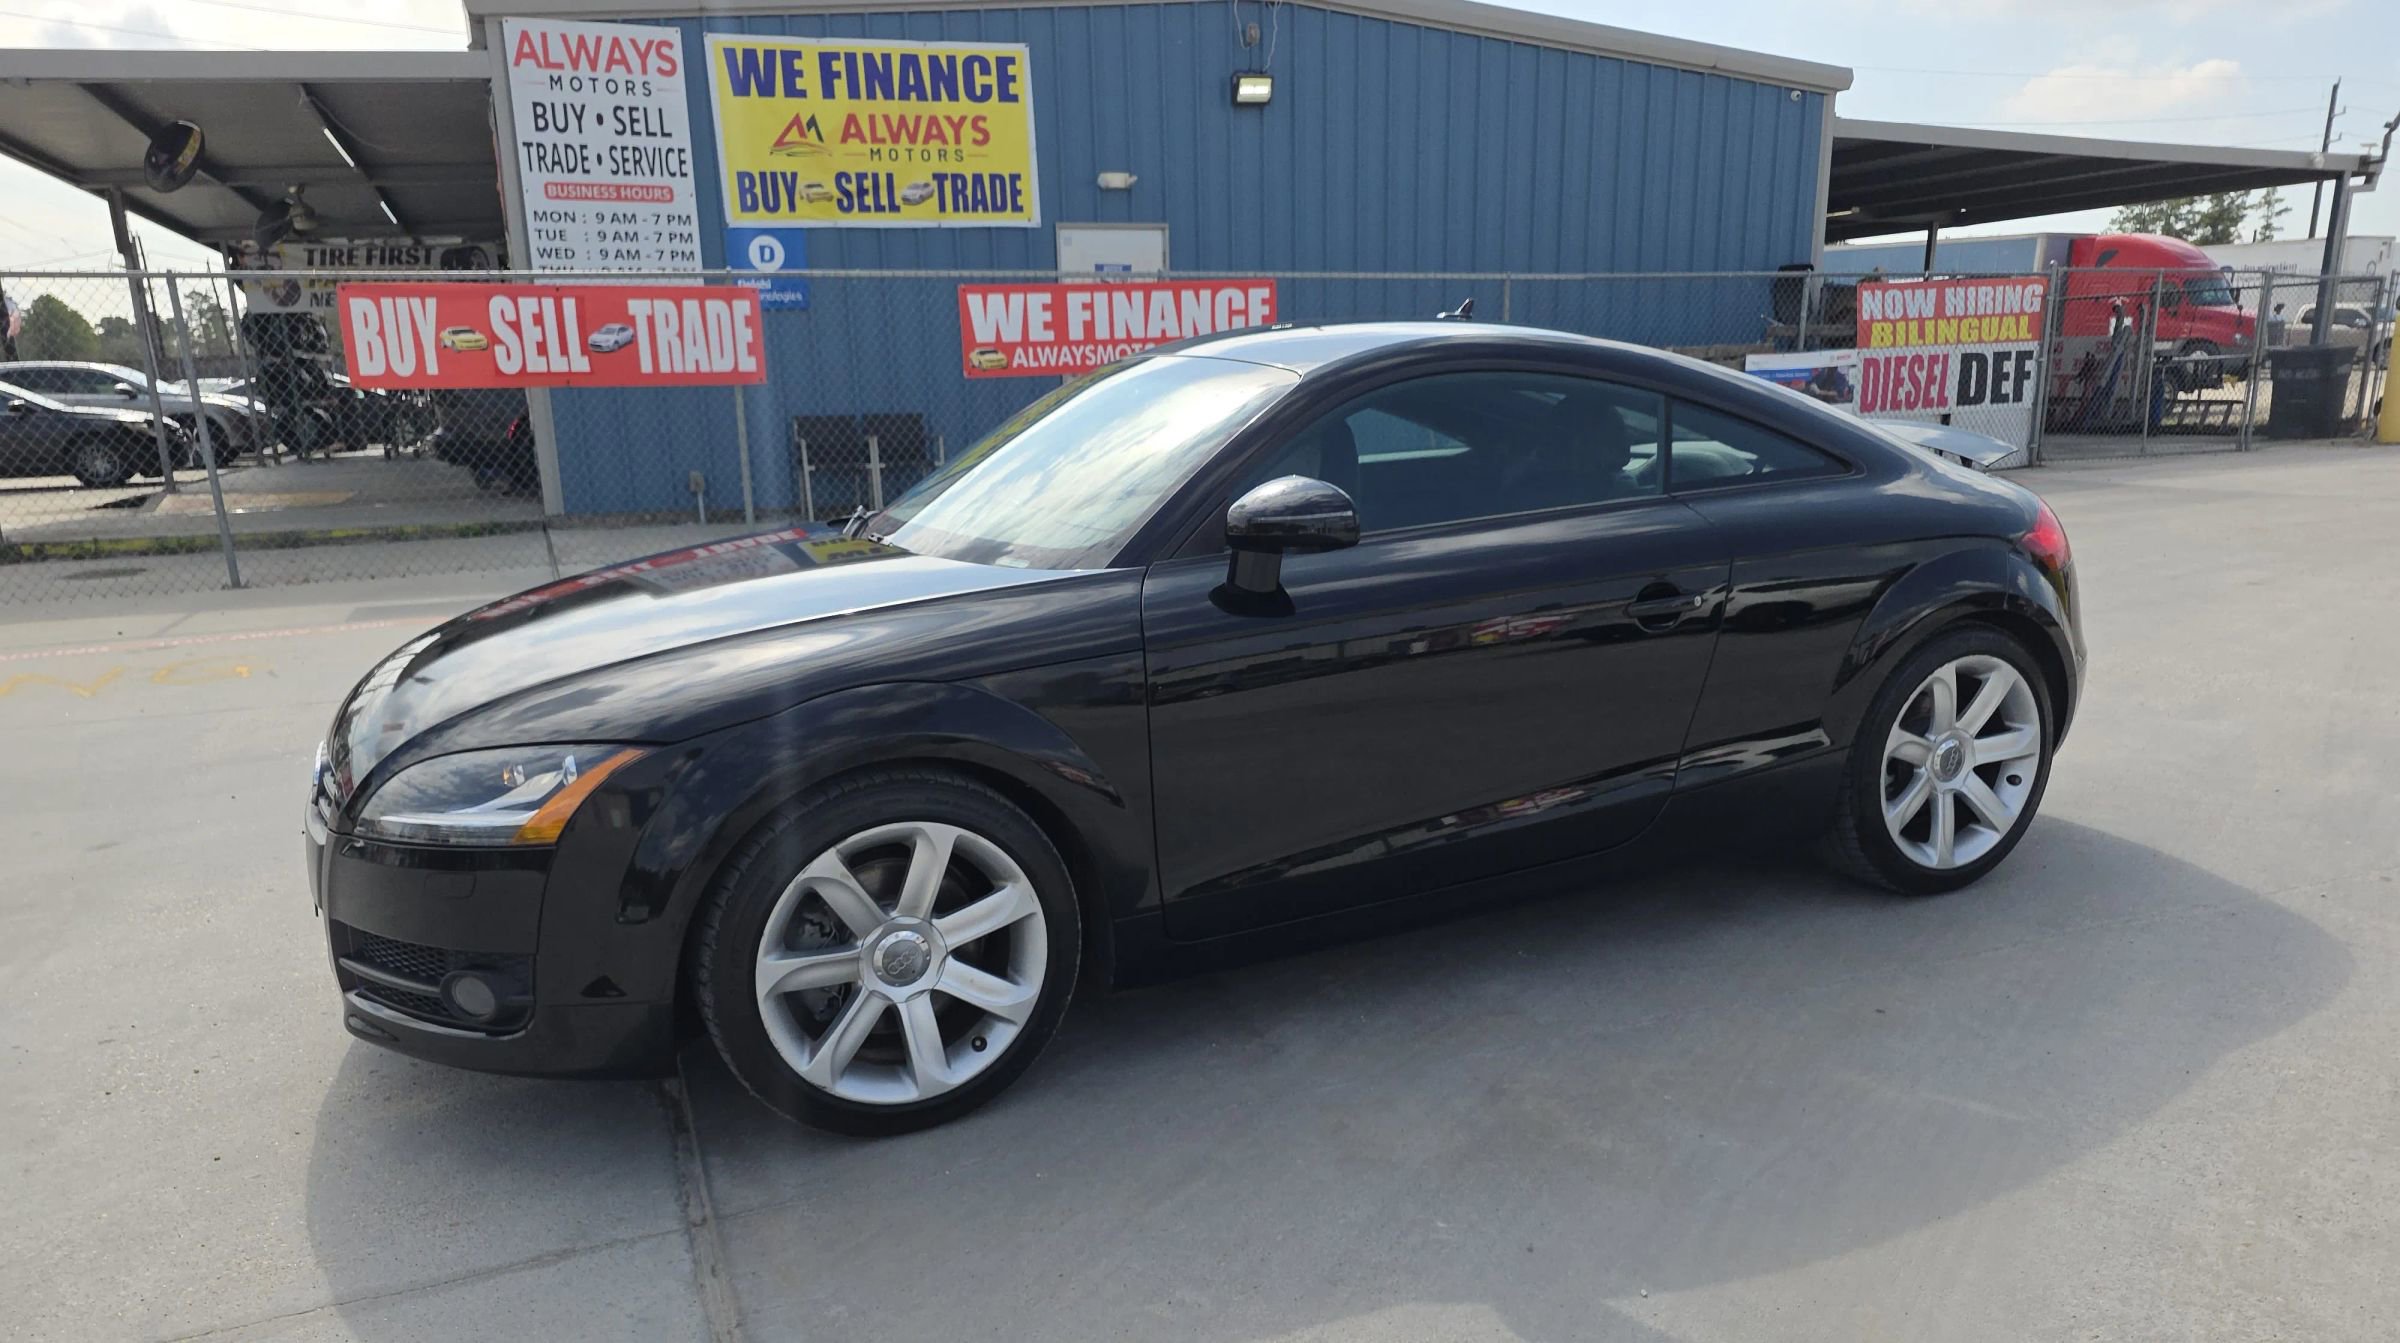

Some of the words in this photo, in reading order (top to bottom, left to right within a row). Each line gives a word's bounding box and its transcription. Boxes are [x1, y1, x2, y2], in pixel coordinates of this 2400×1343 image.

[513, 30, 678, 78] ALWAYS
[549, 75, 653, 97] MOTORS
[723, 47, 807, 98] WE
[818, 51, 1019, 103] FINANCE
[532, 101, 586, 134] BUY
[613, 105, 673, 138] SELL
[840, 112, 991, 147] ALWAYS
[522, 142, 591, 175] TRADE
[609, 145, 688, 178] SERVICE
[870, 148, 964, 162] MOTORS
[547, 184, 618, 200] BUSINESS
[621, 186, 671, 201] HOURS
[736, 171, 798, 214] BUY
[834, 171, 901, 213] SELL
[932, 172, 1024, 213] TRADE
[595, 212, 605, 224] 9
[610, 212, 637, 225] AM
[667, 214, 692, 226] PM
[597, 231, 607, 242] 9
[612, 231, 639, 243] AM
[669, 232, 693, 244] PM
[303, 247, 360, 266] TIRE
[365, 246, 434, 266] FIRST
[599, 249, 609, 260] 9
[614, 249, 641, 261] AM
[670, 251, 695, 262] PM
[967, 292, 1055, 344] WE
[1066, 287, 1270, 342] FINANCE
[1862, 288, 1937, 321] NOW
[1945, 284, 2044, 317] HIRING
[349, 296, 439, 377] BUY
[489, 295, 590, 375] SELL
[627, 299, 757, 374] TRADE
[1871, 315, 2032, 349] BILINGUAL
[1859, 353, 1950, 413] DIESEL
[1956, 350, 2035, 407] DEF
